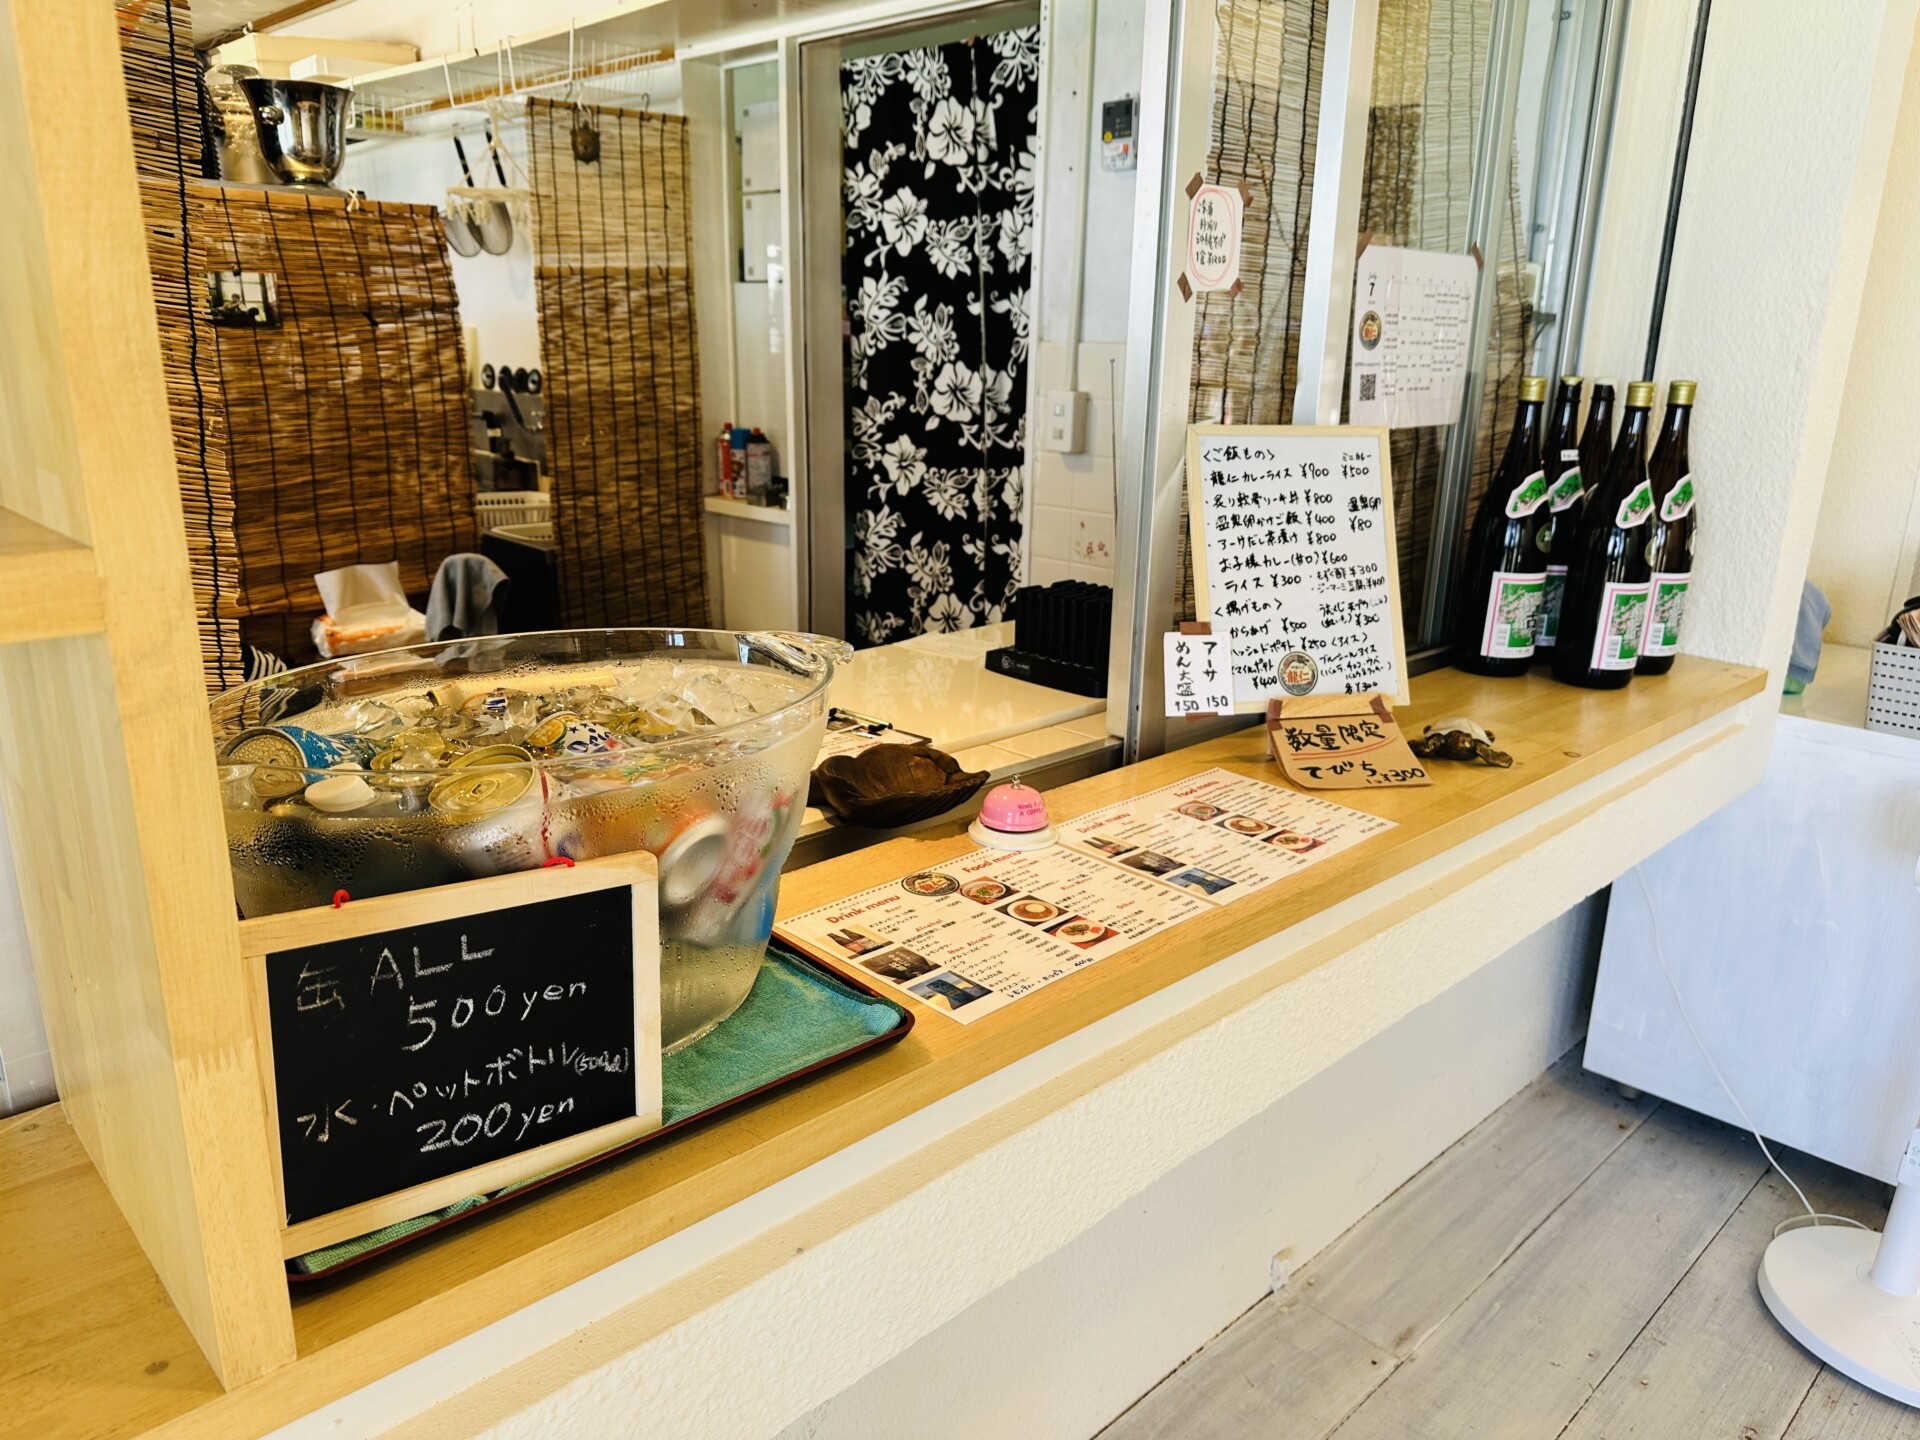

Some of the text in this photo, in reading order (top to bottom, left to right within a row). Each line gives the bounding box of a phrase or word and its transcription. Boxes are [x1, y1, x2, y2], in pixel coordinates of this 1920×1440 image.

[1369, 282, 1376, 296] 7
[1301, 463, 1329, 480] ¥900
[1342, 464, 1369, 479] ¥500
[1304, 489, 1333, 506] ¥800
[1305, 511, 1335, 527] ¥400
[1349, 516, 1372, 532] ¥80
[1307, 531, 1336, 545] ¥800
[1322, 550, 1347, 564] ¥600
[1349, 563, 1377, 578] ¥300
[1224, 573, 1302, 593] ライス ¥300
[1282, 617, 1307, 634] ¥500
[1202, 641, 1218, 682] アーサ
[1252, 675, 1278, 690] ¥400
[1175, 700, 1199, 711] 150
[1207, 695, 1229, 710] 150
[1285, 720, 1386, 752] 数量限定
[1299, 761, 1377, 779] てびち
[1076, 822, 1105, 833] Drink
[1105, 813, 1130, 823] menu
[962, 860, 992, 873] Food
[992, 850, 1022, 863] menu
[826, 895, 900, 923] Drink menu
[884, 905, 901, 913] Beer
[1116, 900, 1135, 909] Other
[915, 919, 943, 932] Alcohol
[916, 941, 939, 952] ハイボール
[925, 942, 953, 957] レモンサワー
[947, 933, 993, 954] Non Alcohol
[944, 943, 989, 965] ノンアルコールビール
[371, 934, 496, 997] ALL
[969, 960, 1004, 977] マンゴージュース
[988, 971, 1021, 988] ホットコーヒー
[1000, 976, 1031, 993] アイスコーヒー
